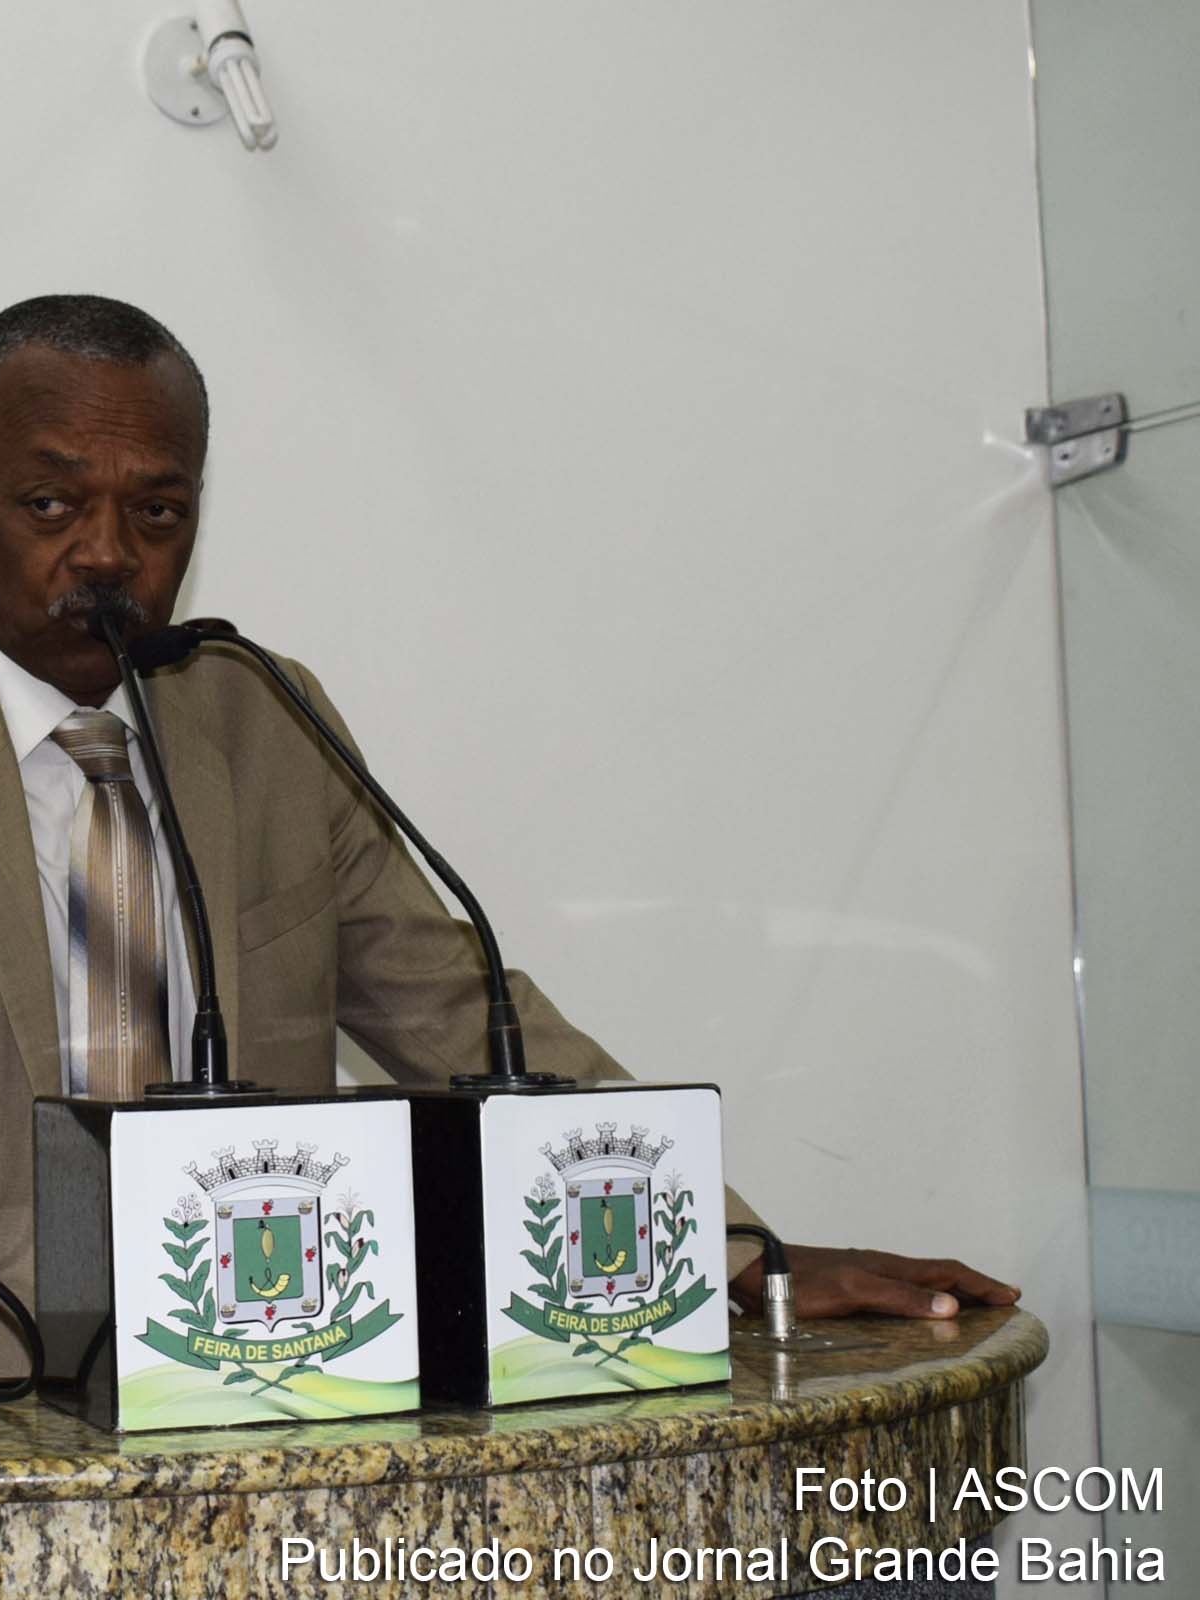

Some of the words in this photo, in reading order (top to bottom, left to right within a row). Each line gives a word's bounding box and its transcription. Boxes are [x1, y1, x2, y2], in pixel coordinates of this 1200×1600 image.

[548, 1310, 587, 1332] FEIRA
[590, 1317, 609, 1333] DE
[612, 1300, 672, 1332] SANTANA
[194, 1336, 242, 1360] FEIRA
[245, 1344, 268, 1361] DE
[272, 1326, 346, 1359] SANTANA
